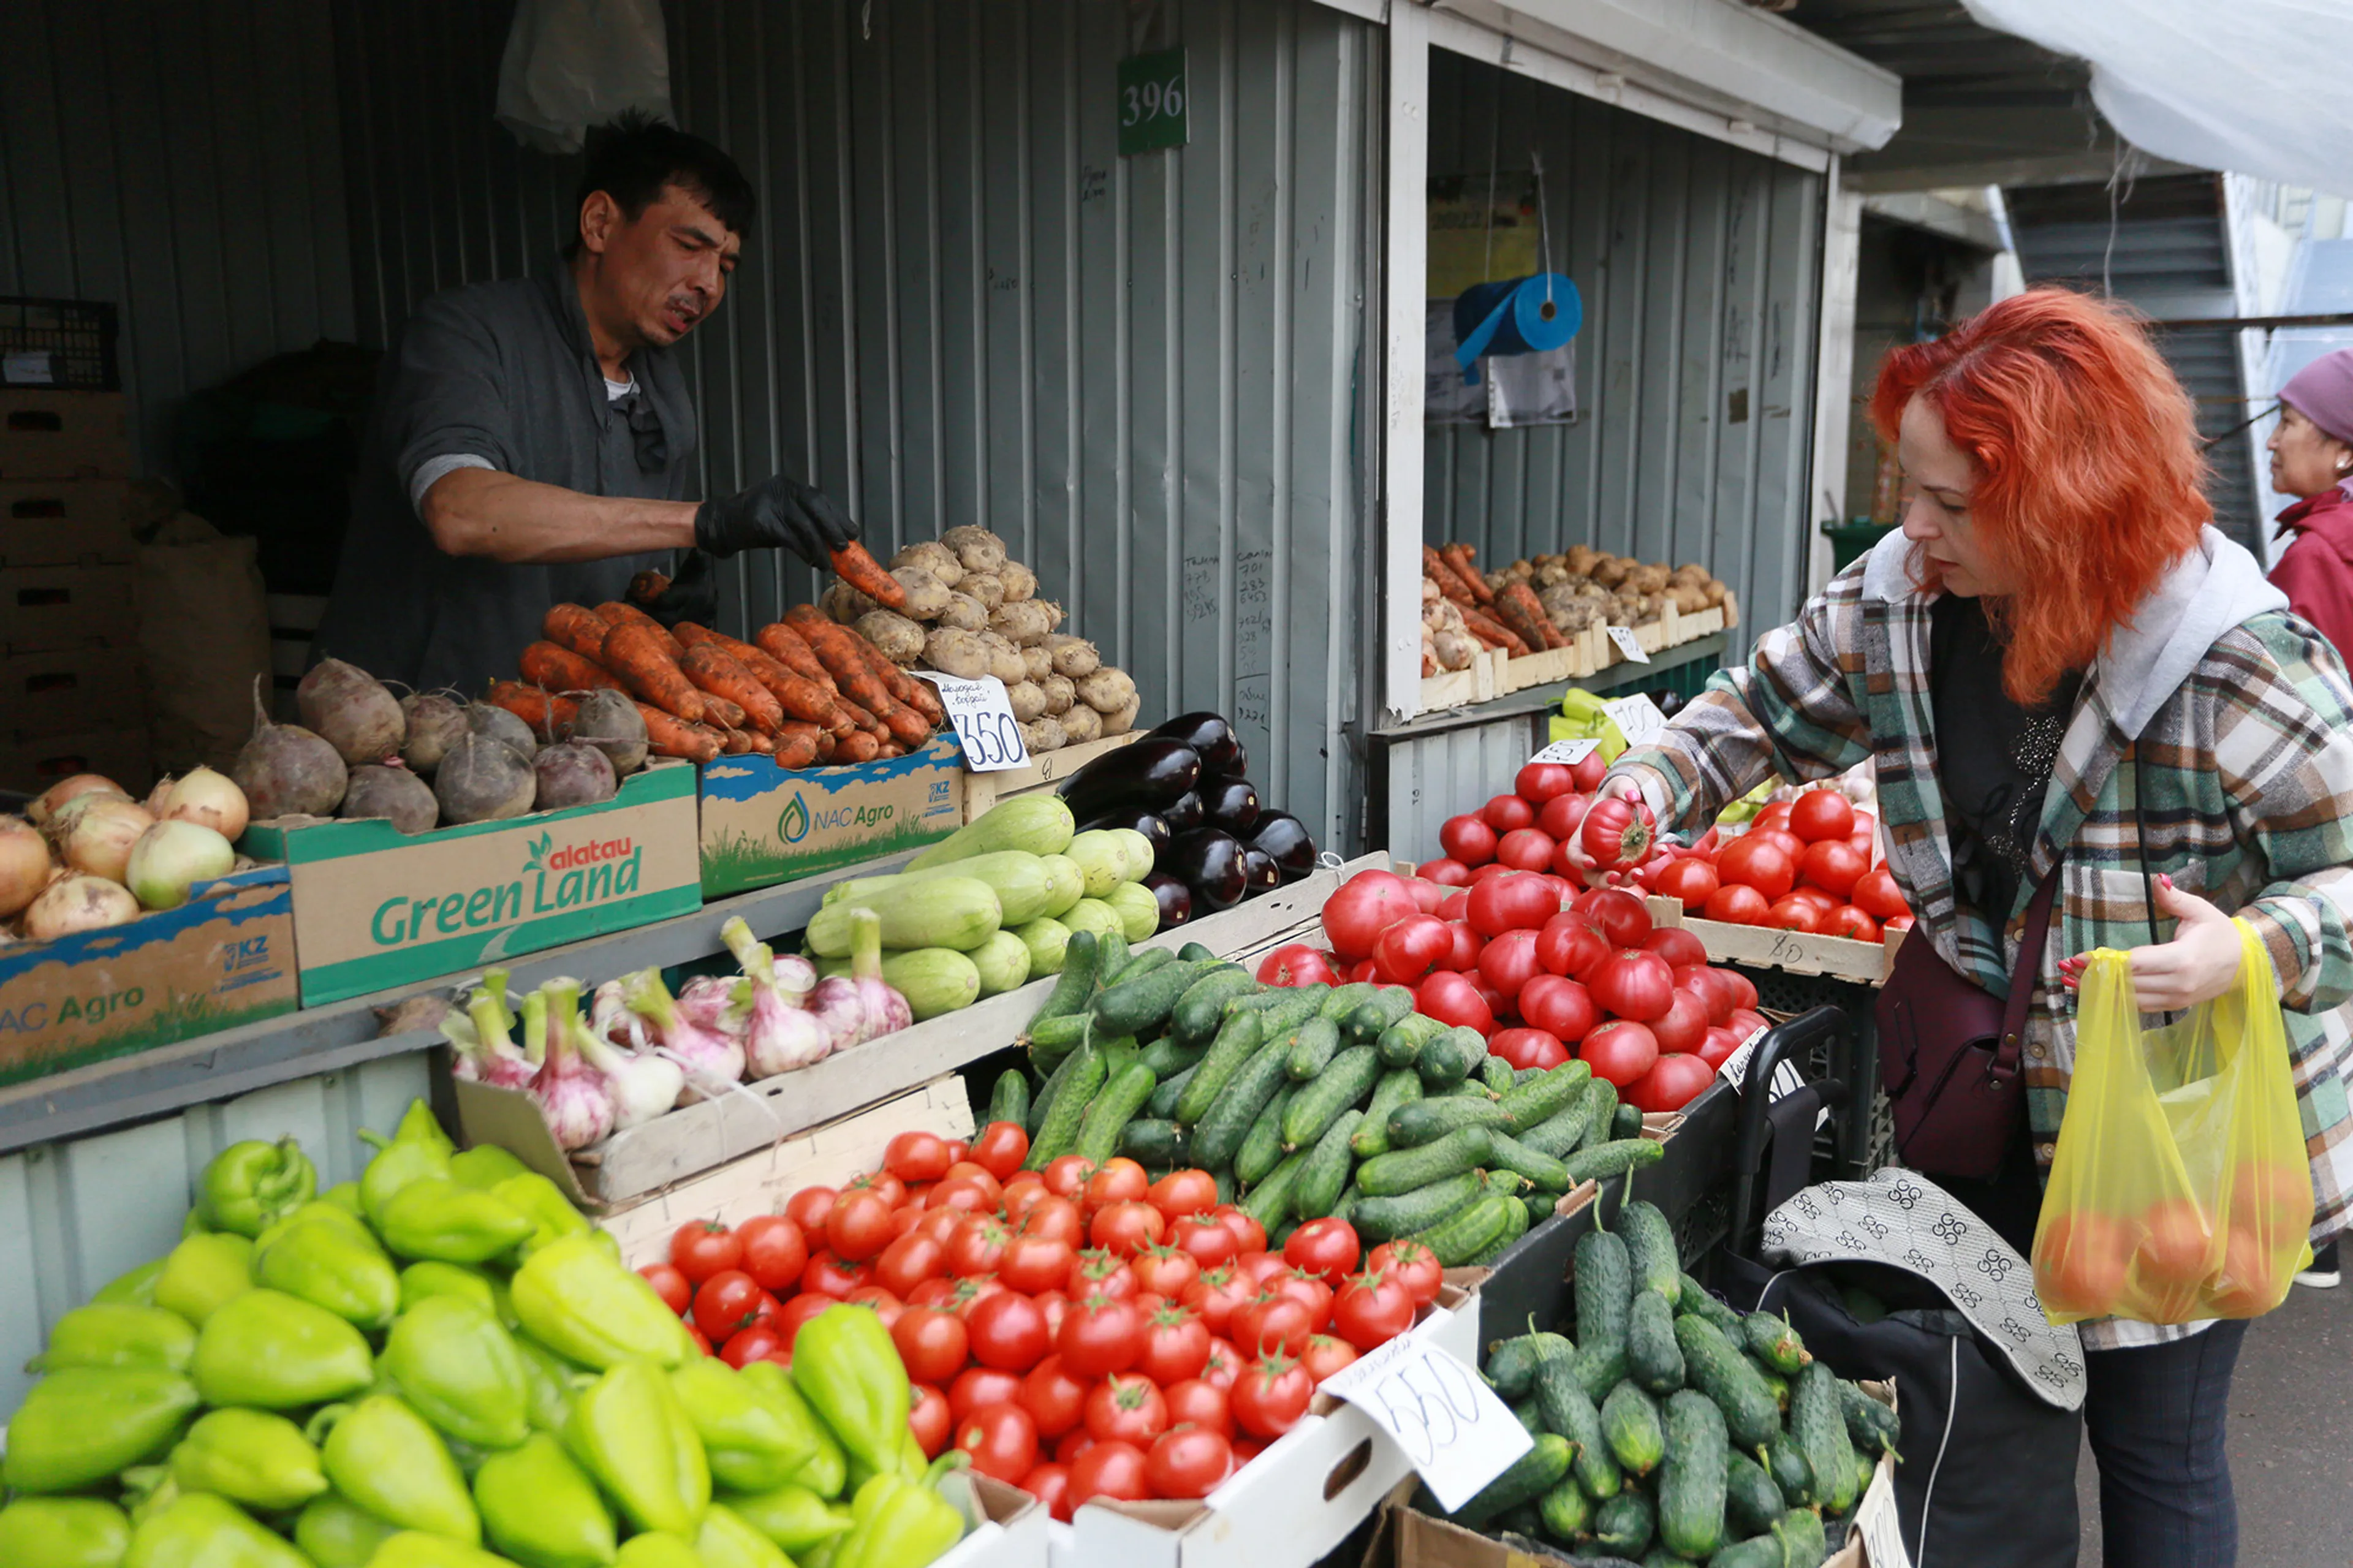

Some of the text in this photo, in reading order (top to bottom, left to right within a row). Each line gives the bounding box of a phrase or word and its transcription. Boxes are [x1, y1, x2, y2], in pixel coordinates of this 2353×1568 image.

[1123, 75, 1183, 126] 396
[1614, 703, 1661, 735] 700
[953, 712, 1023, 765] 350
[936, 781, 950, 793] KZ
[814, 805, 894, 830] NAC Agro
[550, 836, 632, 871] alatau
[371, 845, 642, 946] Green Land
[239, 936, 268, 958] KZ
[1768, 933, 1803, 963] 80
[56, 986, 145, 1026] Agro
[1374, 1350, 1479, 1466] 550
